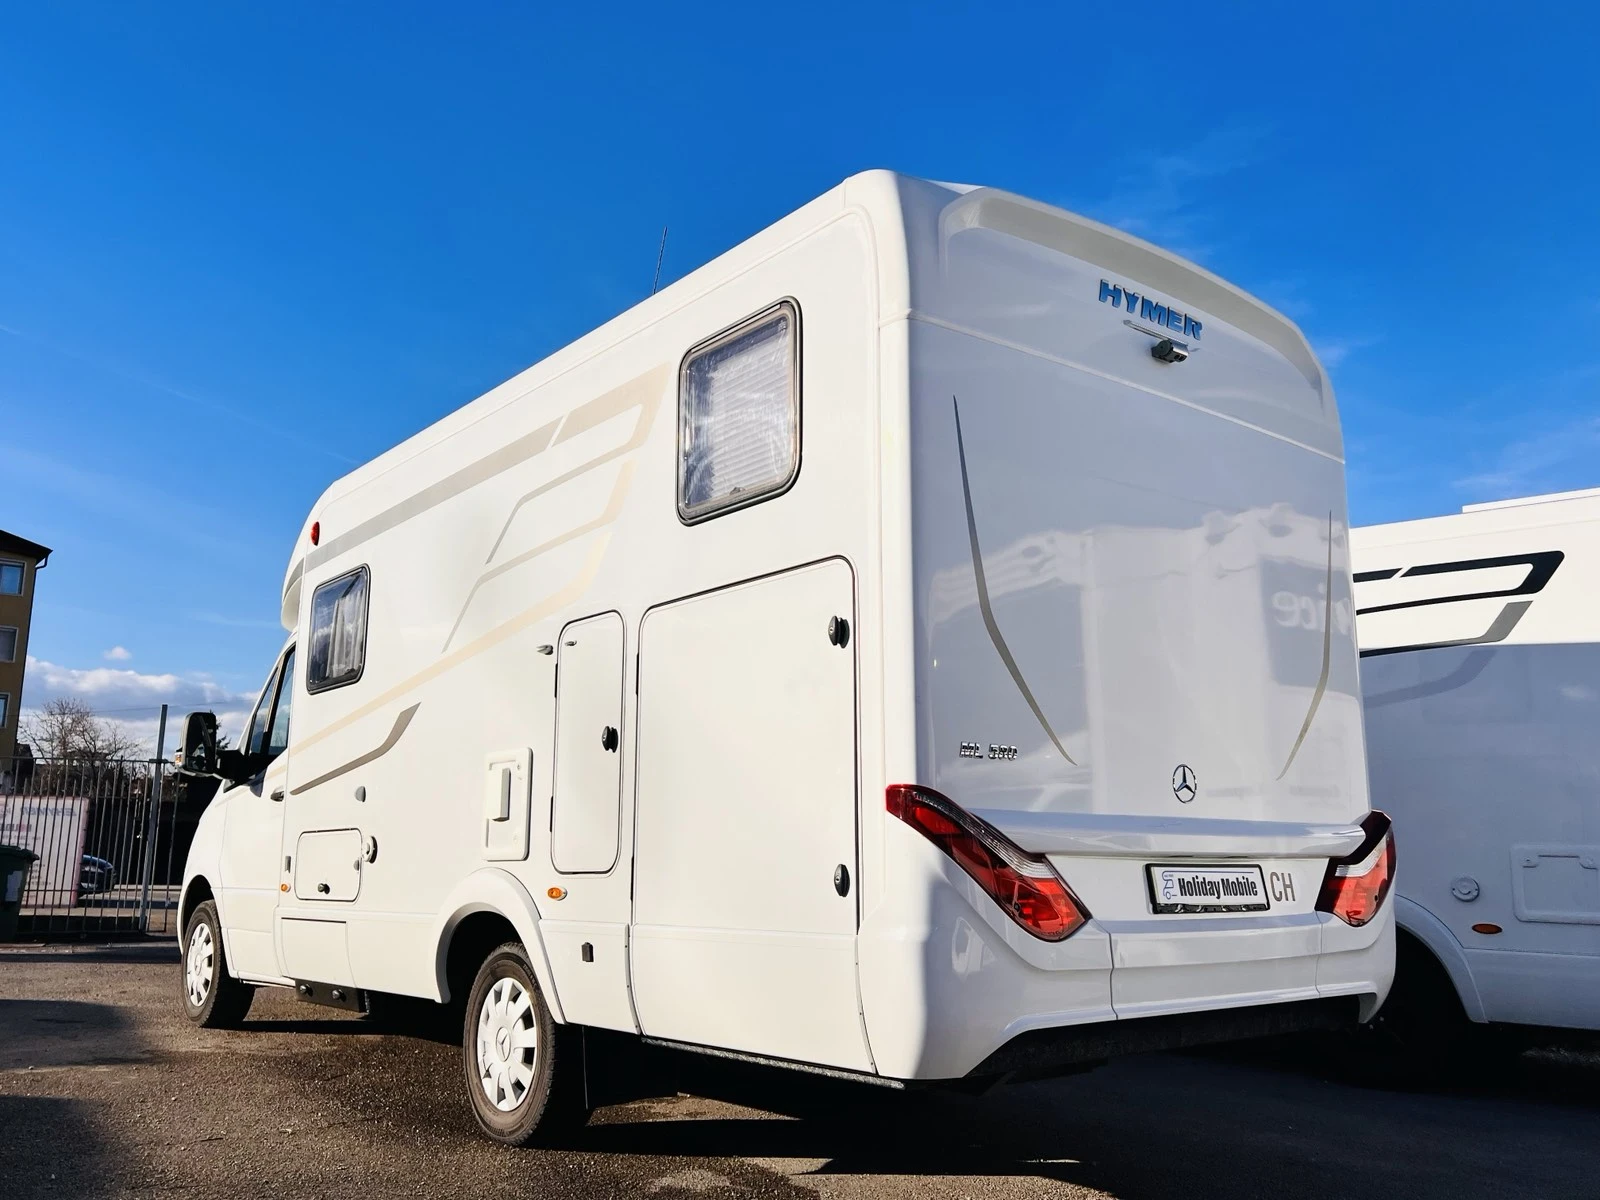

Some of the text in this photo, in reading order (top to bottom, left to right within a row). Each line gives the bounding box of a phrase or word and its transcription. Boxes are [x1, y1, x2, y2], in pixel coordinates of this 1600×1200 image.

[1099, 279, 1203, 341] HYMER
[960, 742, 1018, 761] ML 580
[1178, 875, 1258, 900] Holiday Mobile
[1269, 871, 1296, 902] CH
